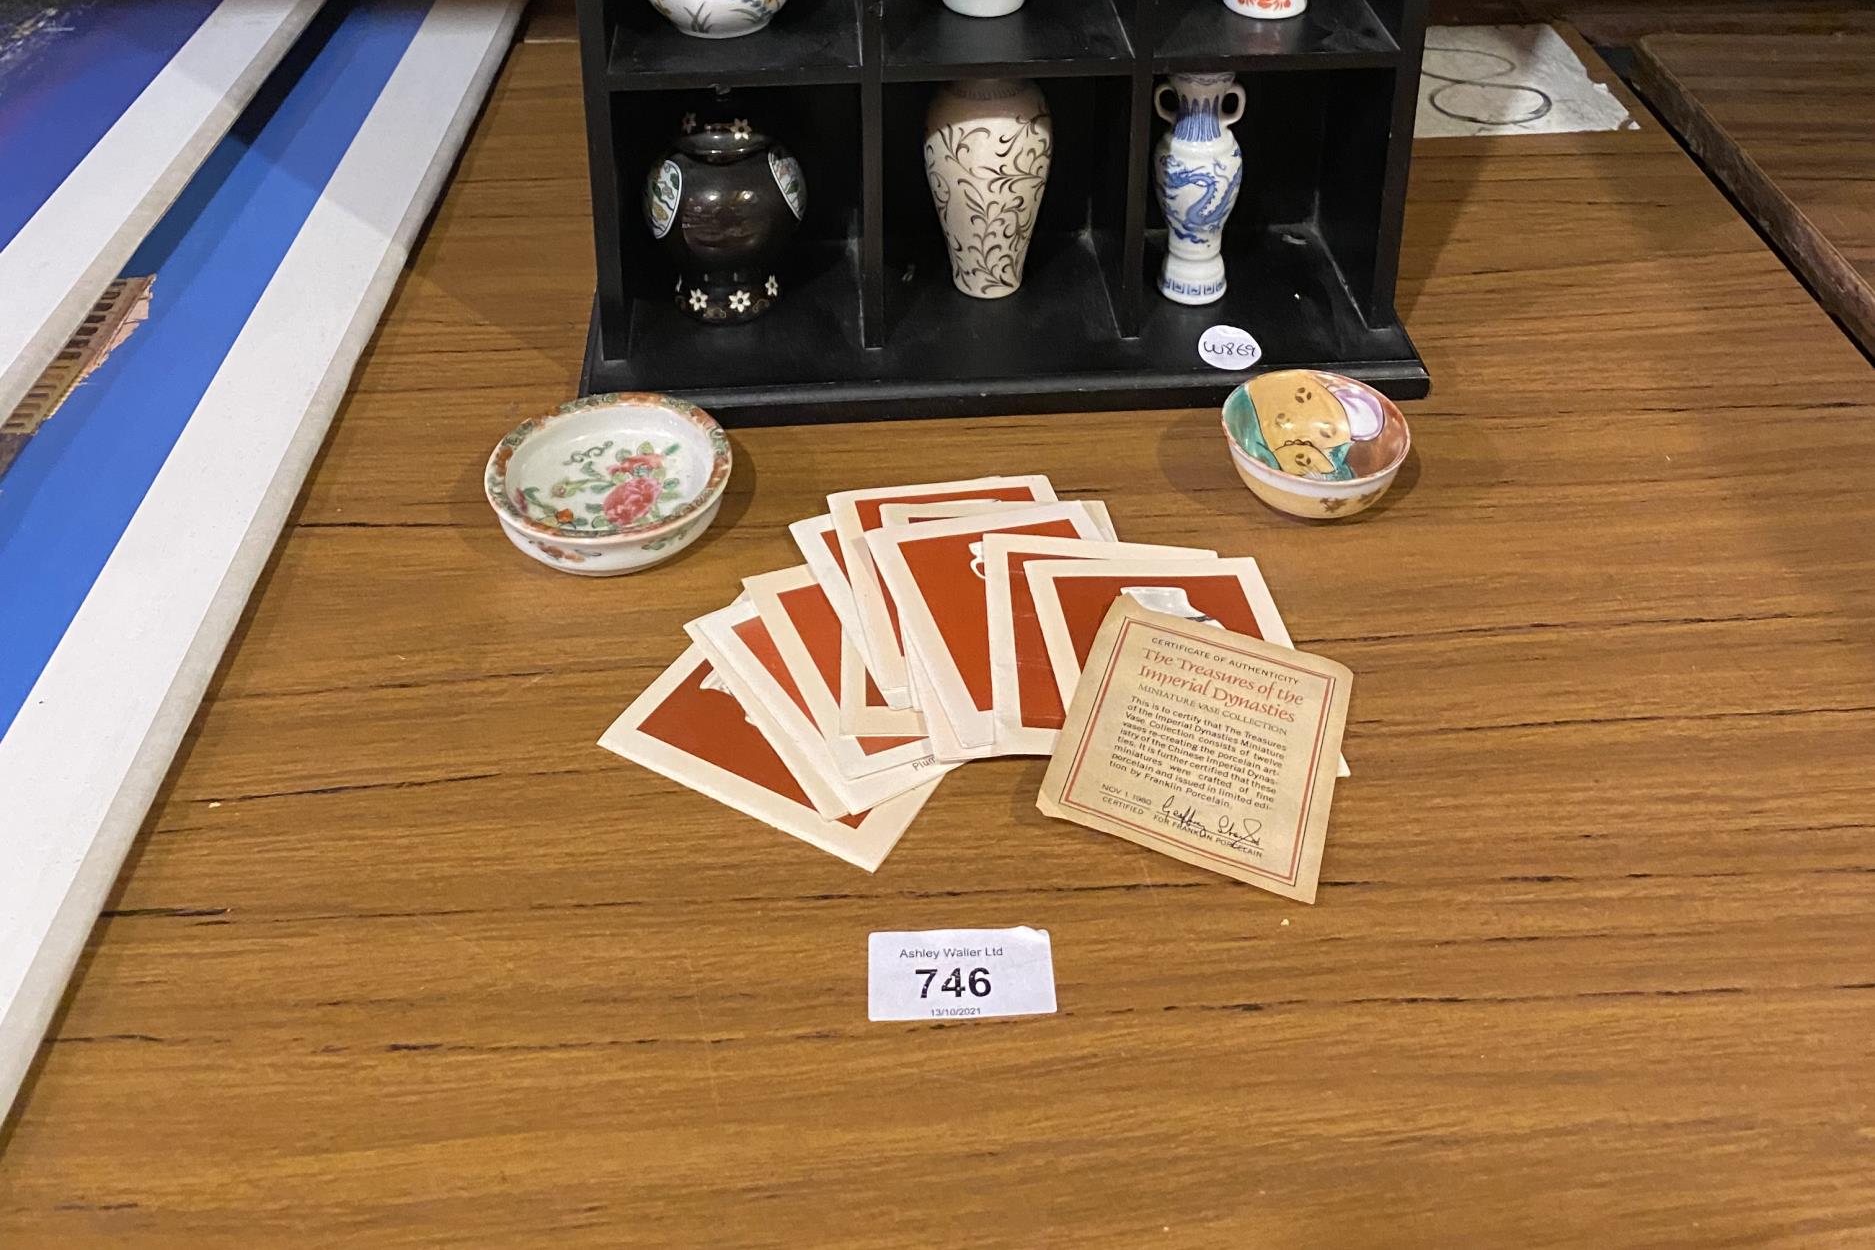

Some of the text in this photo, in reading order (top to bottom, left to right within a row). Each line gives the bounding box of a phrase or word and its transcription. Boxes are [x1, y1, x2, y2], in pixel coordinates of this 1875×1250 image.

[1142, 647, 1304, 706] The Treasures of the
[1152, 638, 1210, 660] CERTIFICATE
[1228, 660, 1300, 685] AUTHENTICITY
[1138, 664, 1295, 723] Imperial Dynasties
[1138, 683, 1288, 736] MINIATURE VASE COLLECTION
[1131, 696, 1149, 708] This
[1162, 706, 1170, 714] to
[1172, 710, 1201, 724] certify
[1204, 718, 1221, 729] that
[1225, 726, 1242, 736] The
[1245, 731, 1287, 750] Treasures
[1139, 708, 1152, 718] the
[1155, 713, 1193, 730] Imperial
[1194, 725, 1238, 744] Dynasties
[1240, 739, 1284, 759] Miniature
[1149, 720, 1194, 740] Collection
[1198, 736, 1236, 752] consists
[1254, 753, 1282, 768] twelve
[1120, 728, 1139, 740] istry
[1152, 739, 1166, 748] the
[1168, 744, 1204, 761] Chinese
[1207, 756, 1245, 774] Imperial
[1247, 770, 1278, 785] Dynas-
[1123, 721, 1279, 776] vases re-creating the porcelain art-
[1147, 746, 1154, 754] is
[1157, 750, 1188, 765] further
[1190, 761, 1229, 777] certified
[1231, 773, 1249, 784] that
[1252, 780, 1276, 794] these
[1102, 784, 1122, 794] NOV
[1110, 761, 1127, 771] tion
[1130, 768, 1141, 777] by
[1145, 773, 1182, 792] Franklin
[1112, 753, 1272, 810] porcelain and issued in limited edi-
[1114, 744, 1162, 766] miniatures
[1170, 765, 1191, 776] were
[1198, 774, 1232, 788] crafted
[1256, 791, 1274, 802] fine
[1102, 796, 1144, 815] CERTIFIED
[1153, 814, 1169, 826] FOR
[900, 947, 1003, 960] Ashley Waller Ltd
[915, 967, 992, 998] 746
[931, 1007, 981, 1016] 13/10/2021
